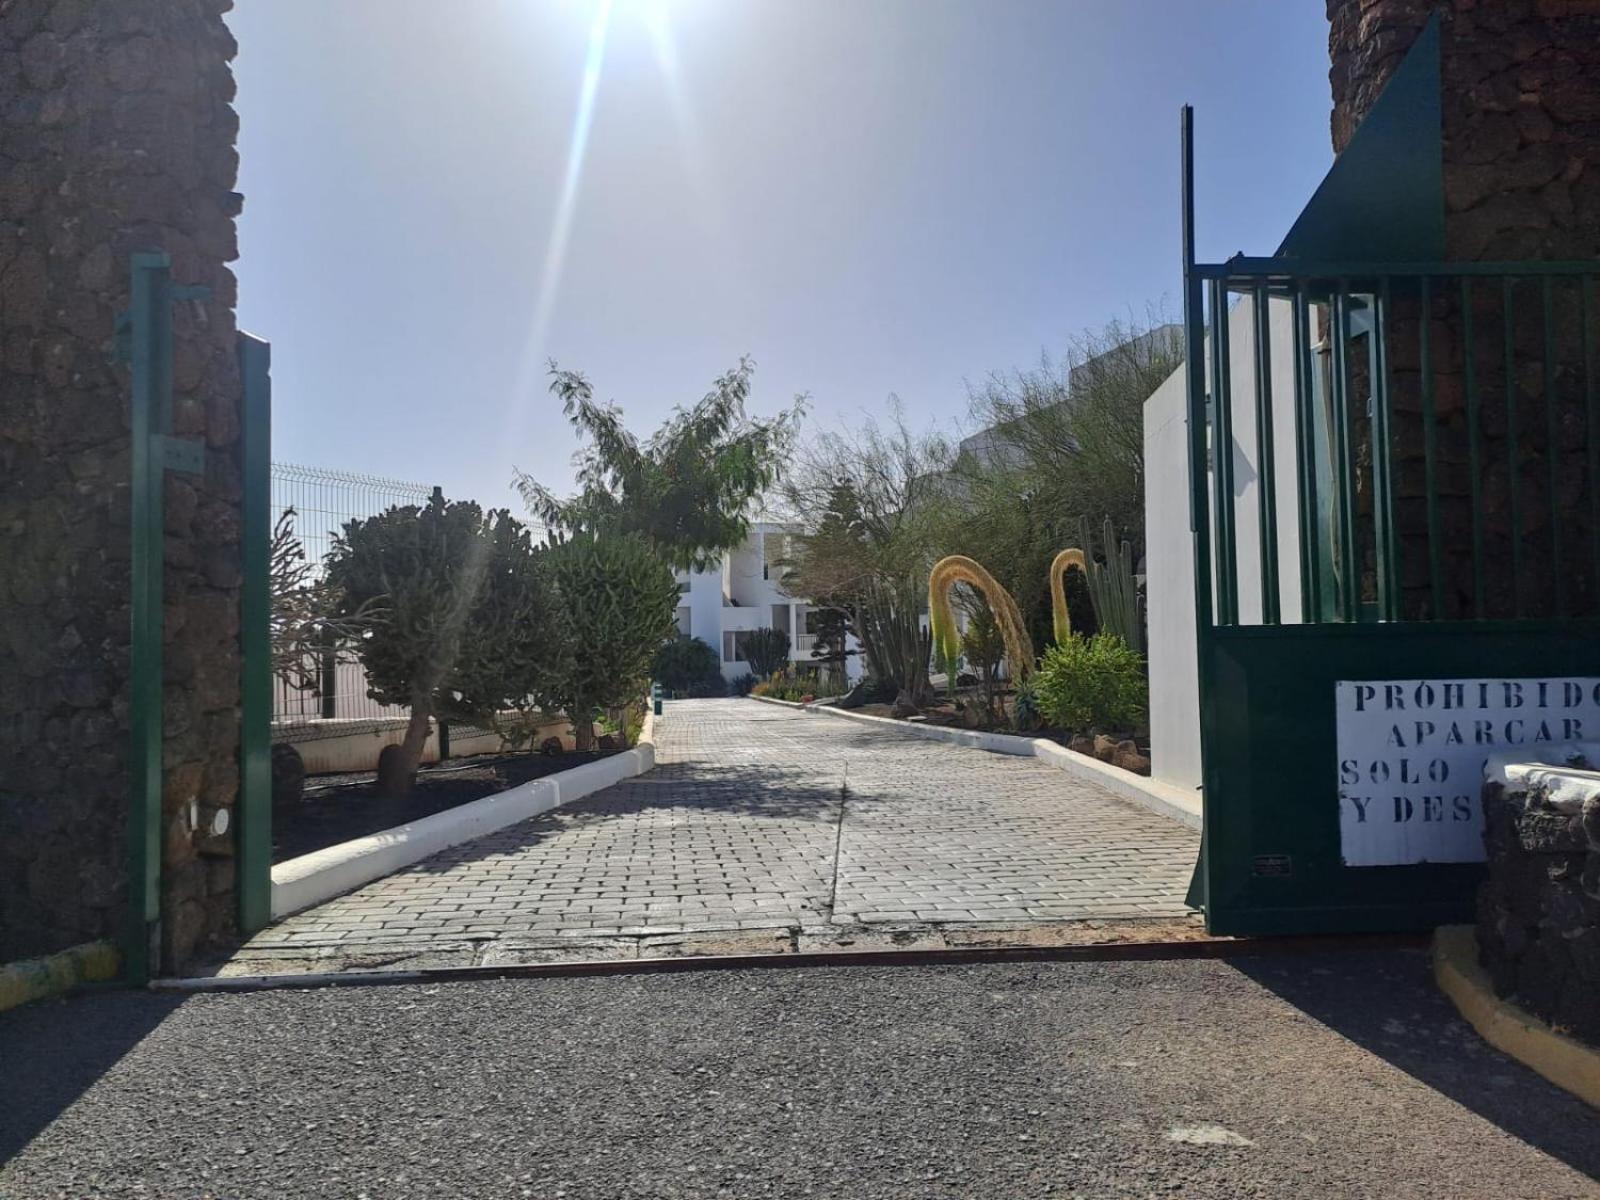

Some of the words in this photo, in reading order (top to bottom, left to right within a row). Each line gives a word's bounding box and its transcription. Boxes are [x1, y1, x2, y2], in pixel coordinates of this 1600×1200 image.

[1389, 718, 1583, 747] APARCAR
[1341, 758, 1449, 785] SOLO
[1350, 797, 1371, 823] Y
[1393, 795, 1472, 823] DES
